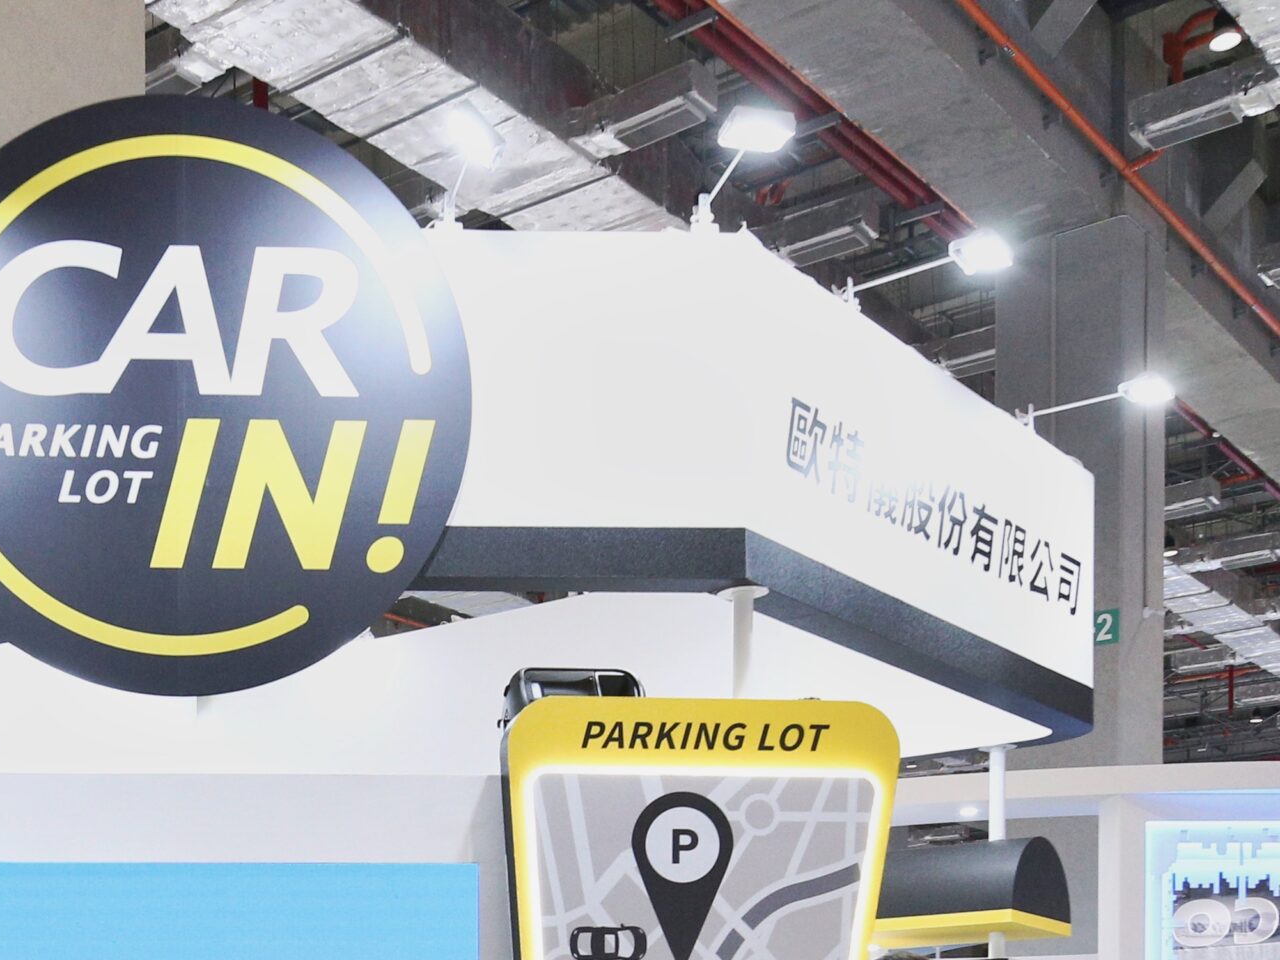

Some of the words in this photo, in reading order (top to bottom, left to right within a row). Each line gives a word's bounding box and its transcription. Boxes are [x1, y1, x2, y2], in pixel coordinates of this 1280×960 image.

[57, 470, 153, 505] LOT
[150, 417, 436, 574] IN!
[581, 721, 746, 752] PARKING
[757, 723, 830, 753] LOT
[671, 829, 699, 864] P
